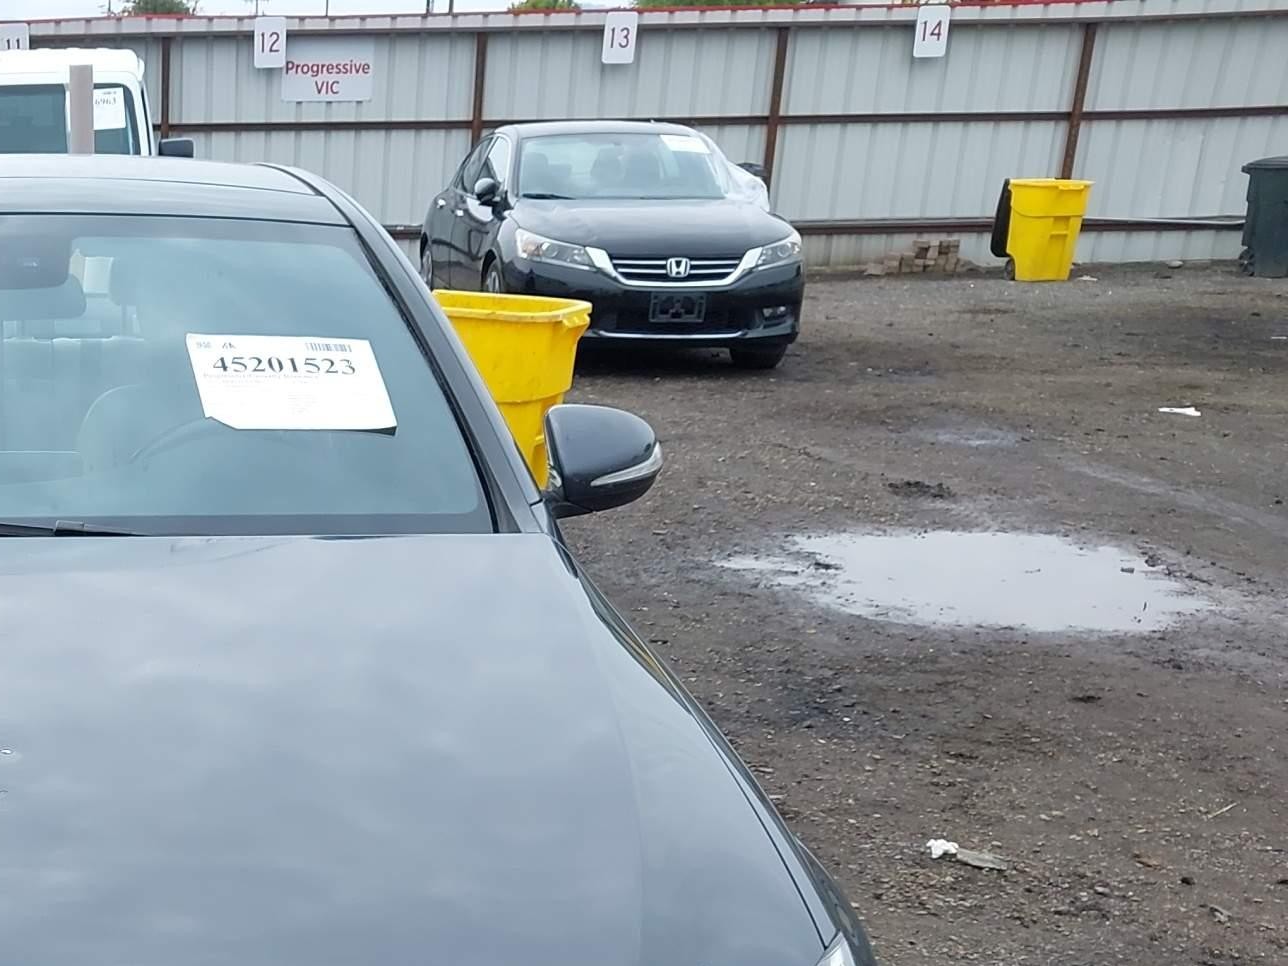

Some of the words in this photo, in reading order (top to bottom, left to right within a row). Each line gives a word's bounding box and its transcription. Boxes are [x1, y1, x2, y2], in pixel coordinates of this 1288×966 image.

[610, 27, 630, 48] 13
[921, 20, 942, 41] 14
[261, 31, 280, 53] 12
[285, 60, 371, 77] Progressive
[314, 80, 340, 95] VIC
[213, 356, 356, 375] 45201523
